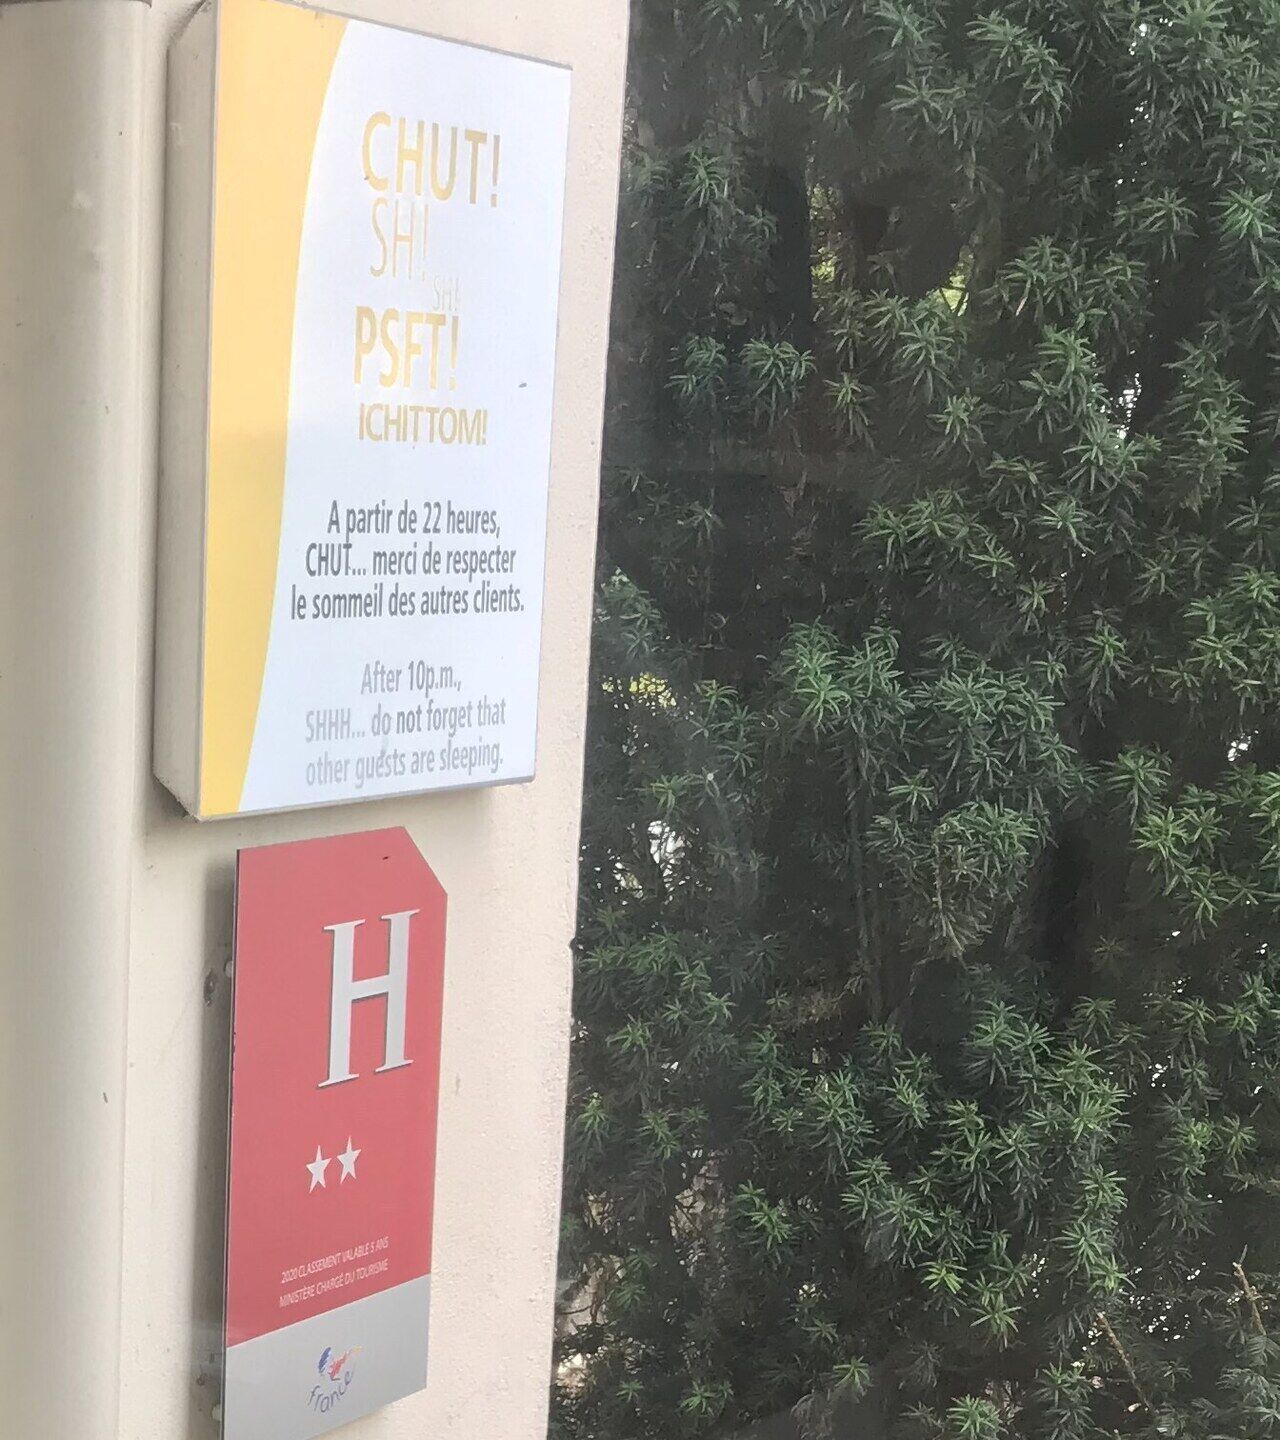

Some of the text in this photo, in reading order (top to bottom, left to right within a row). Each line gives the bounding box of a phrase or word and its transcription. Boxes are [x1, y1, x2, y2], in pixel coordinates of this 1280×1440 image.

[362, 111, 500, 207] CHUT!
[369, 196, 429, 281] SH!
[354, 305, 459, 391] PSFT!
[359, 403, 488, 445] ICHITTOM!
[327, 499, 500, 542] A partir de 22 heures,
[305, 541, 516, 583] CHUT... merci de respecter
[291, 580, 525, 620] le sommeil des autres clients.
[360, 660, 402, 695] After
[305, 696, 507, 743] SHHH... do not forget that
[306, 737, 504, 789] other guests are sleeping.
[317, 908, 420, 1089] H
[298, 1252, 341, 1278] CLASSEMENT
[344, 1271, 356, 1286] DU
[356, 1258, 389, 1280] TOURISME
